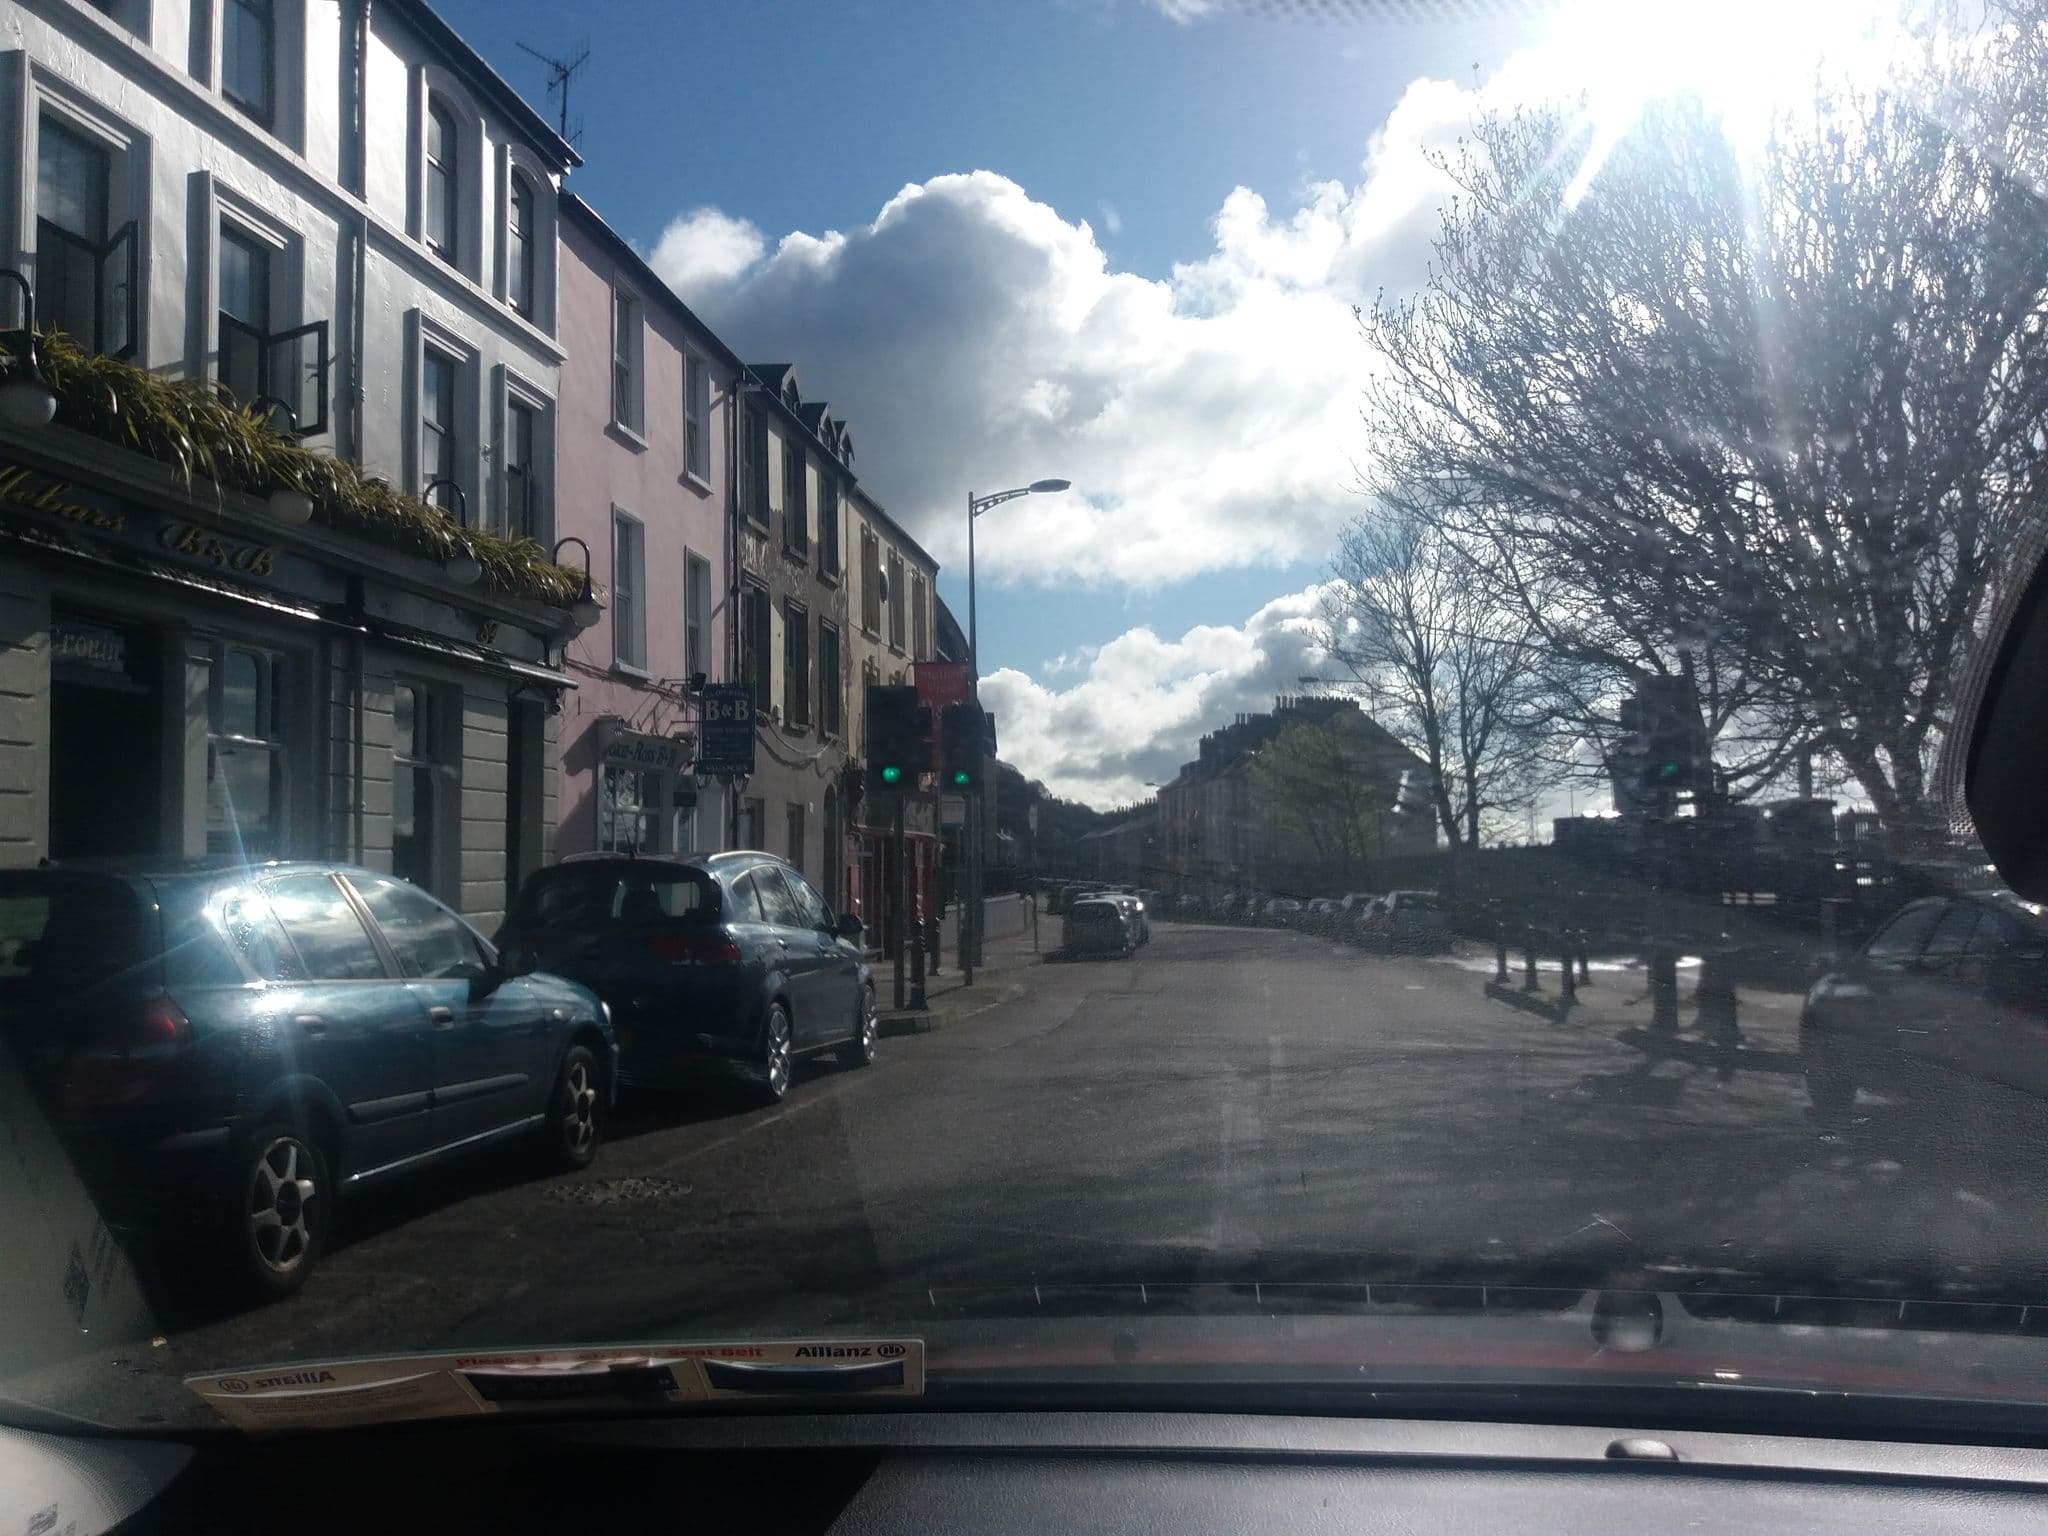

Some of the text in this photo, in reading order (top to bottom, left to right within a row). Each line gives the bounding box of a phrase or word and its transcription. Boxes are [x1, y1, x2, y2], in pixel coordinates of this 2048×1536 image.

[705, 699, 749, 720] B&B
[721, 1347, 763, 1357] Belt
[795, 1345, 873, 1358] Allianz
